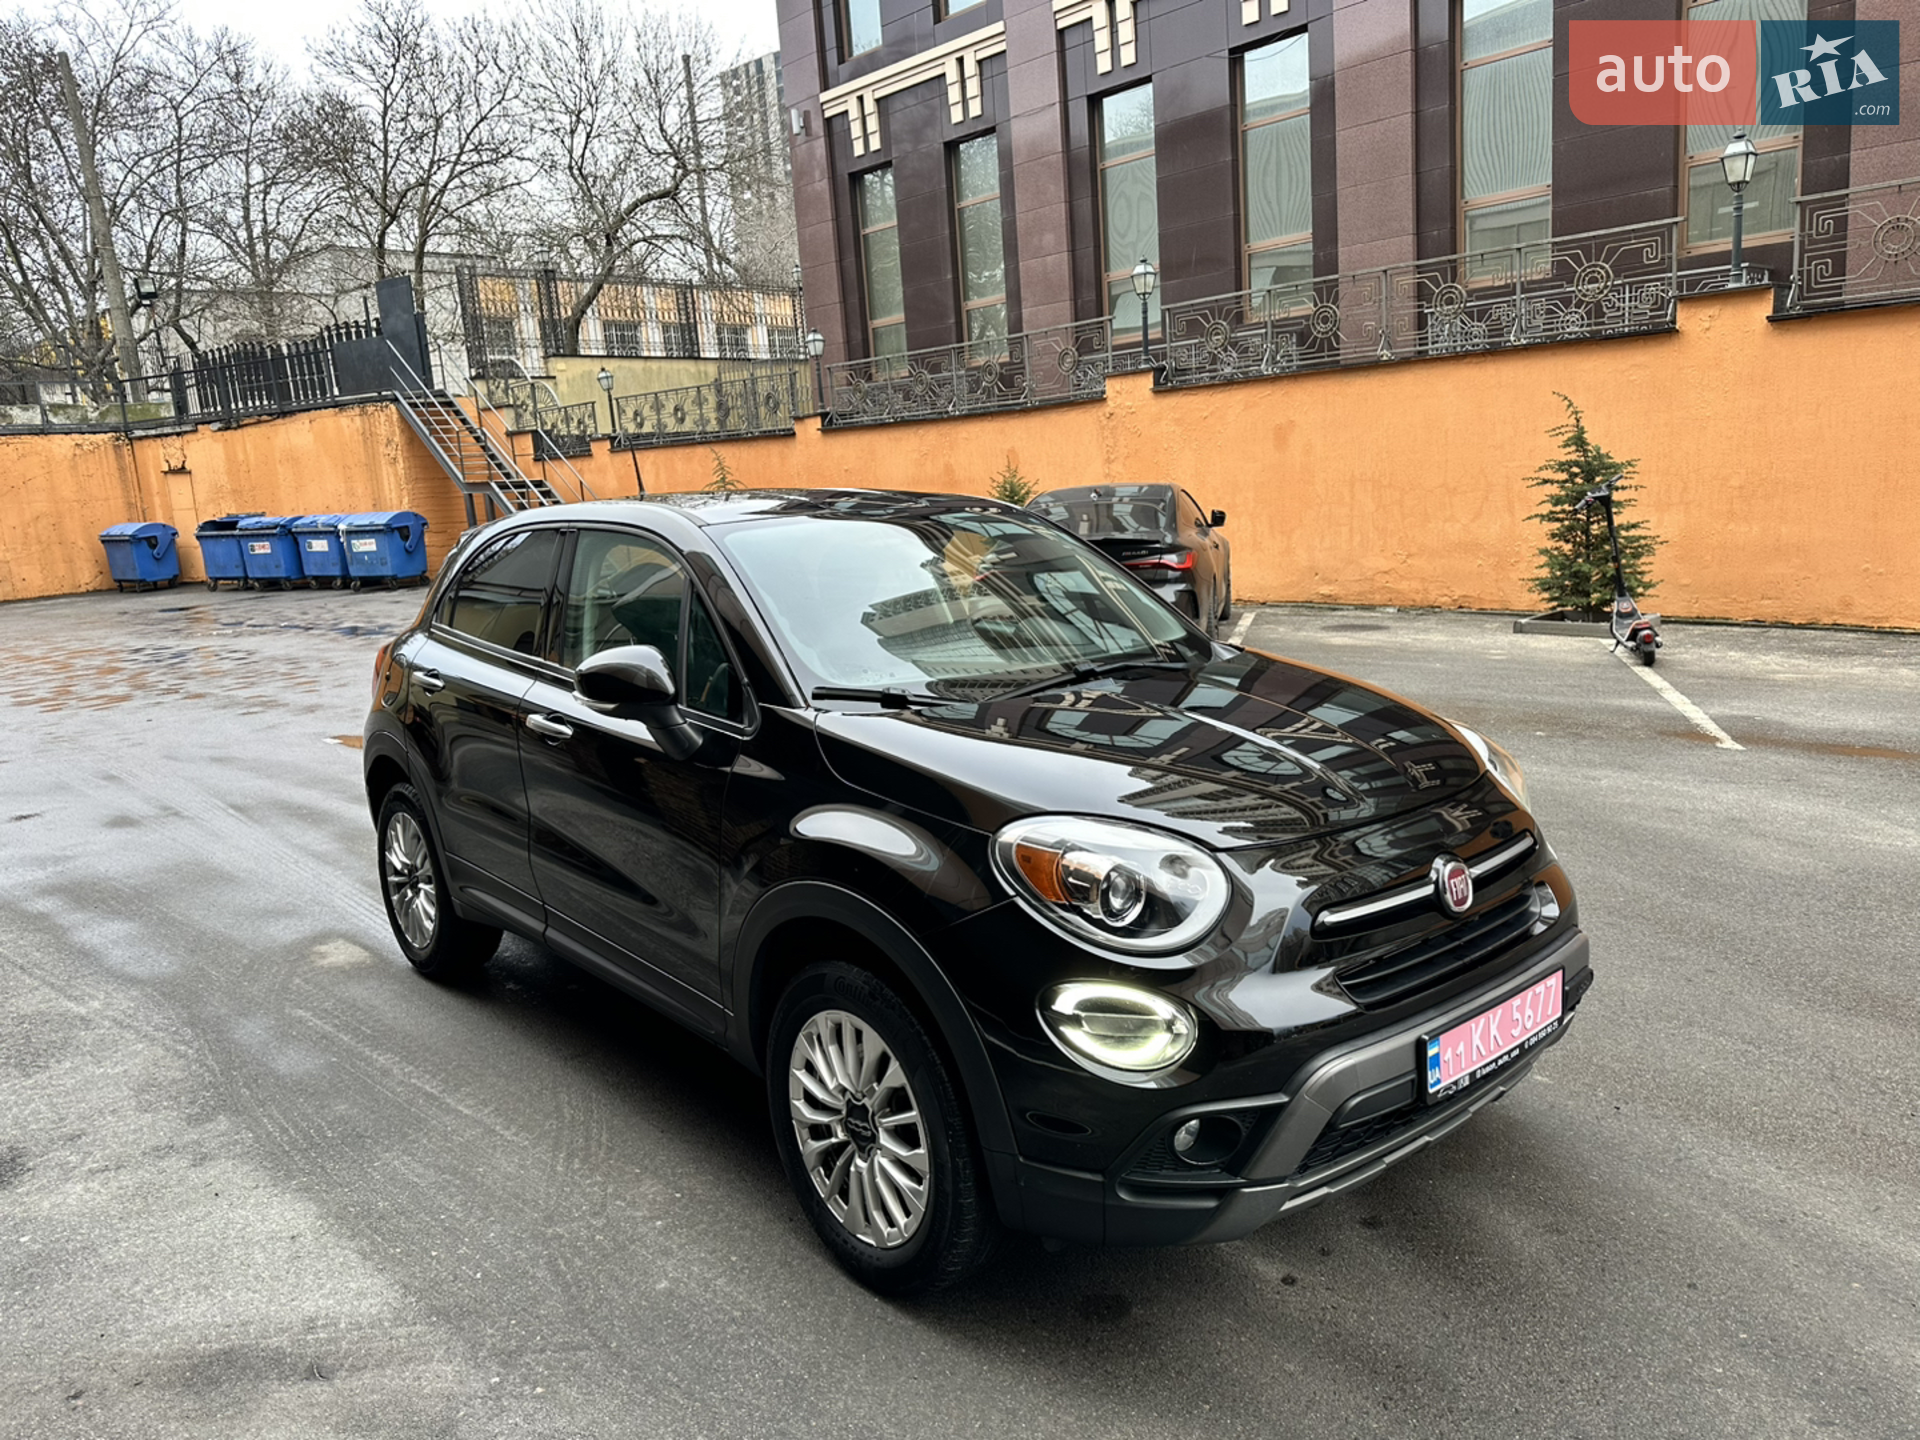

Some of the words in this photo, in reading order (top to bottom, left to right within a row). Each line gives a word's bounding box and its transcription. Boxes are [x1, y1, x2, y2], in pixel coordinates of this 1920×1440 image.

[1450, 874, 1467, 902] FIAT
[1443, 1041, 1465, 1076] 11
[1471, 1008, 1504, 1062] KK
[1511, 977, 1557, 1037] 5677
[1428, 1066, 1441, 1084] UA
